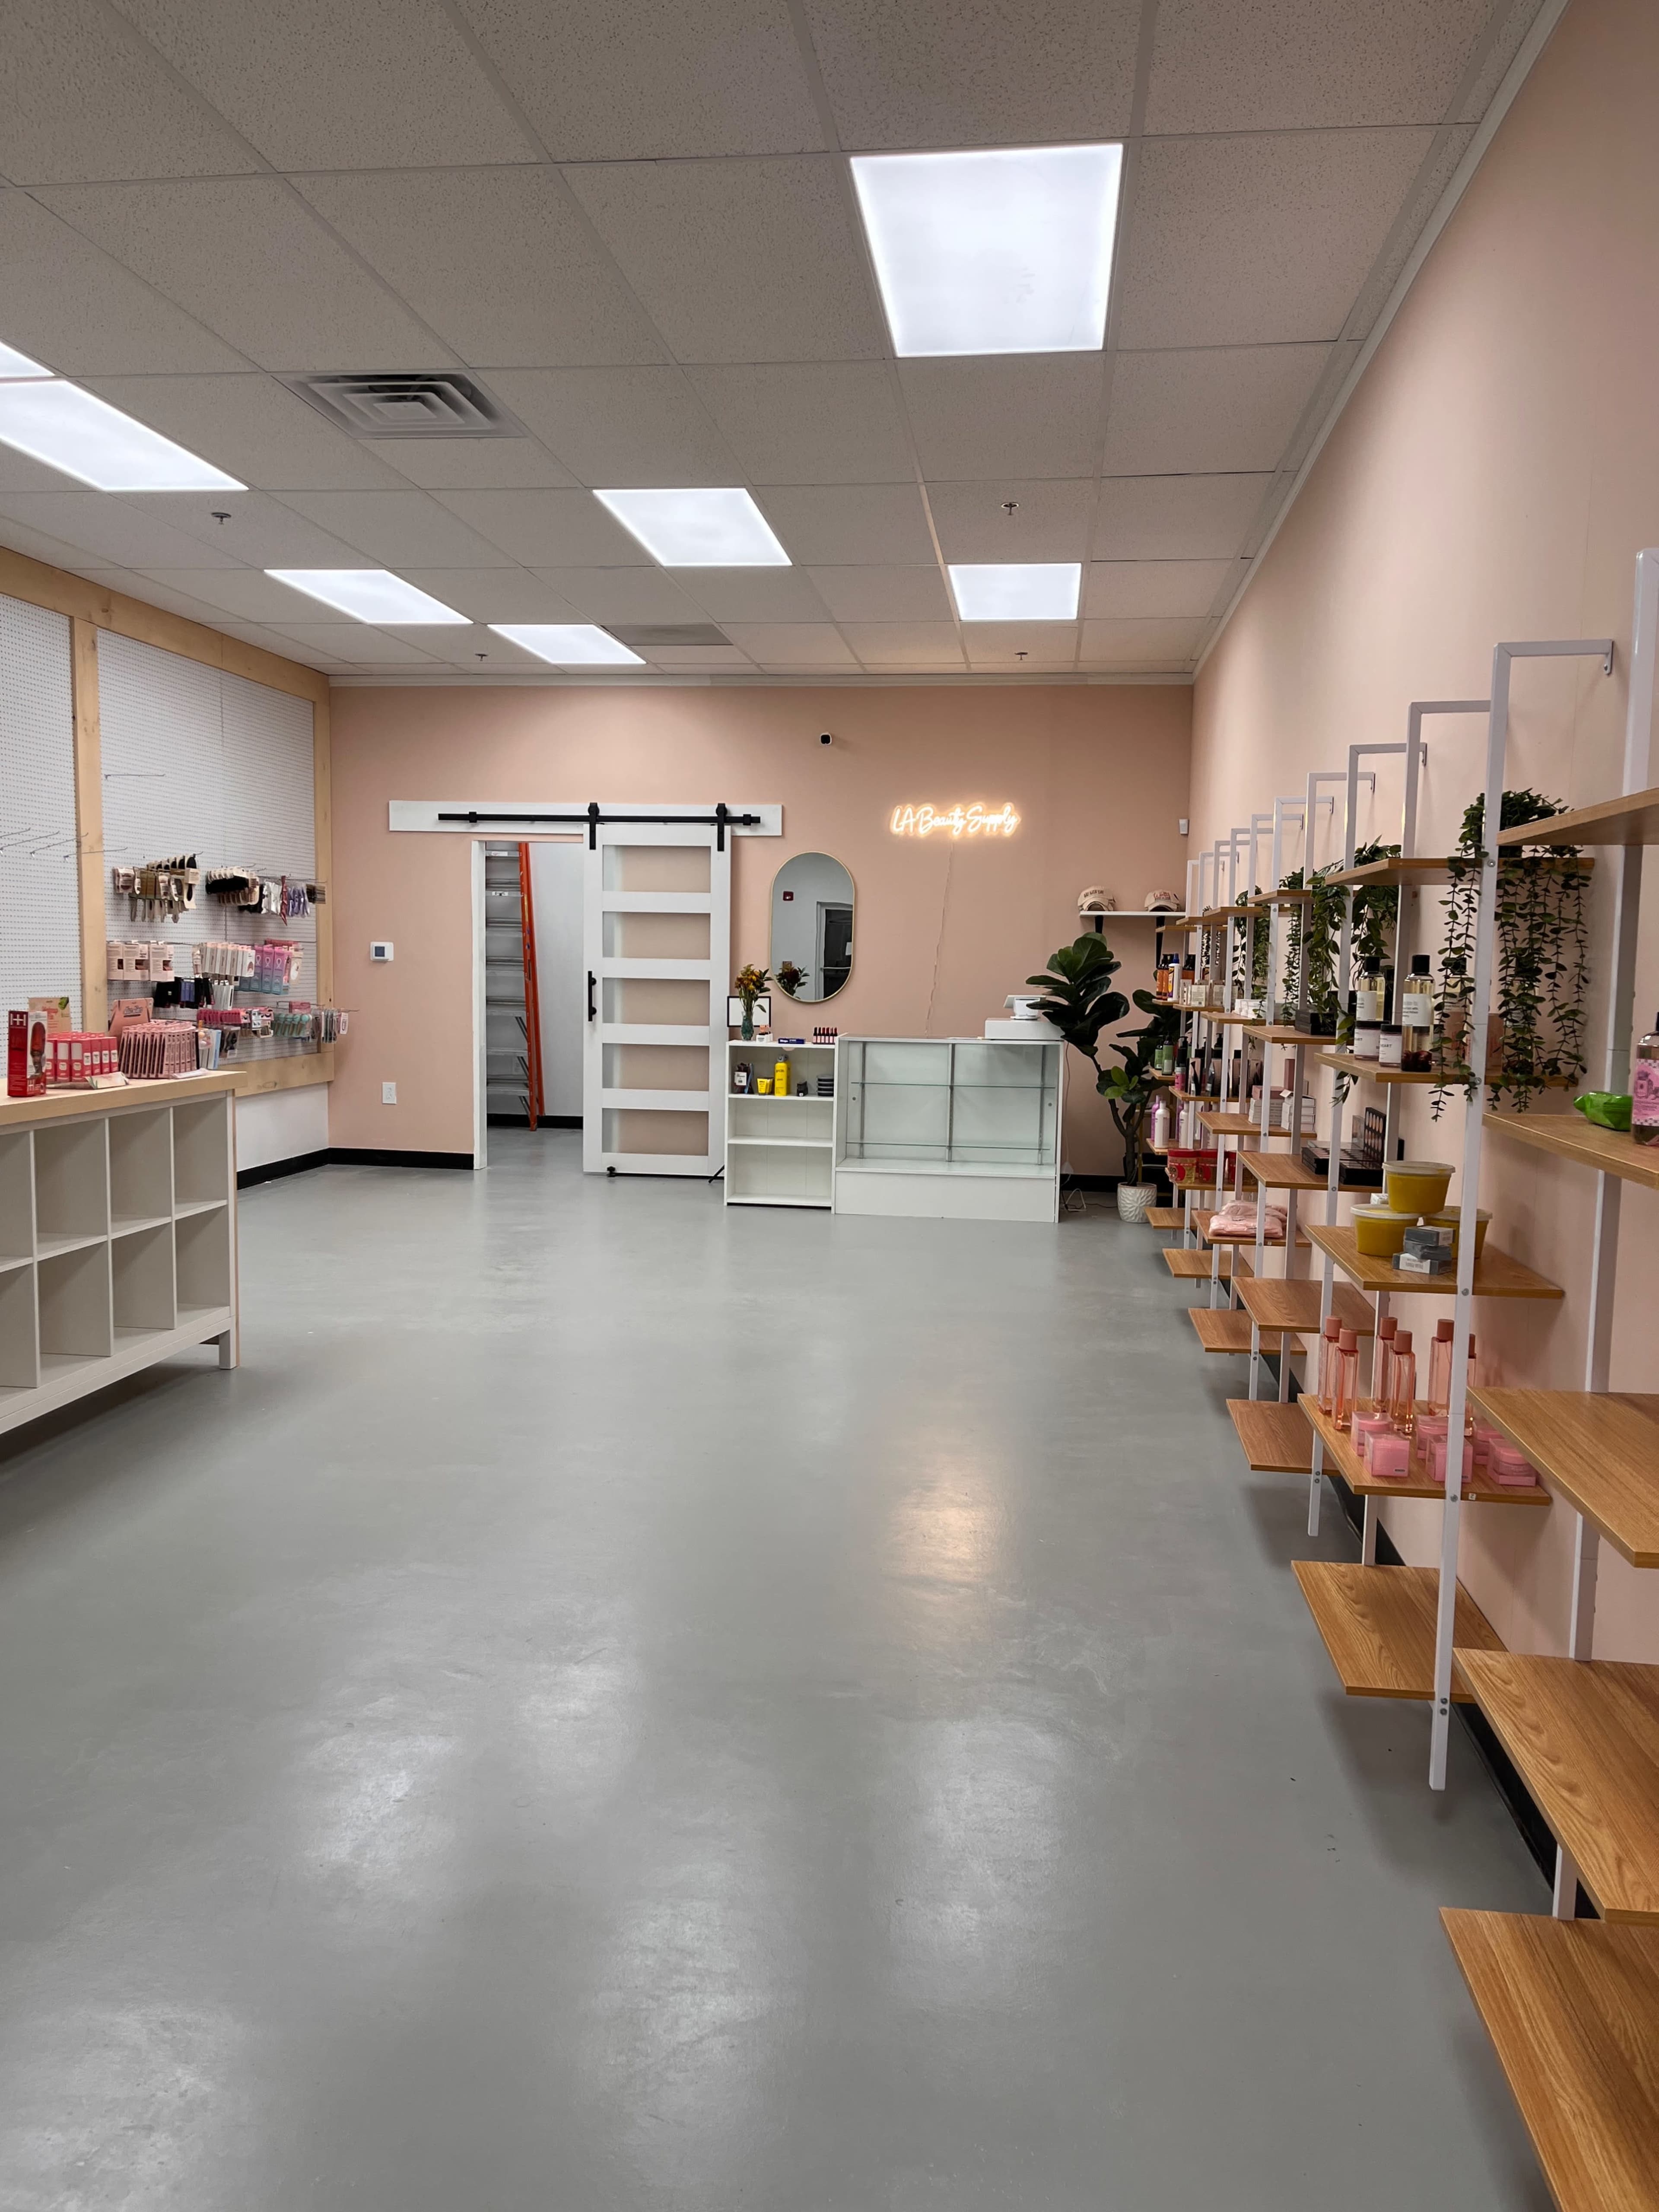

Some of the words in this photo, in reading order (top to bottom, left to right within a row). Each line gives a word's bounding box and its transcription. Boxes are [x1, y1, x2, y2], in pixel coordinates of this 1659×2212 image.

[893, 807, 916, 833] LA
[916, 806, 967, 835] Beauty
[966, 805, 1018, 833] Supply
